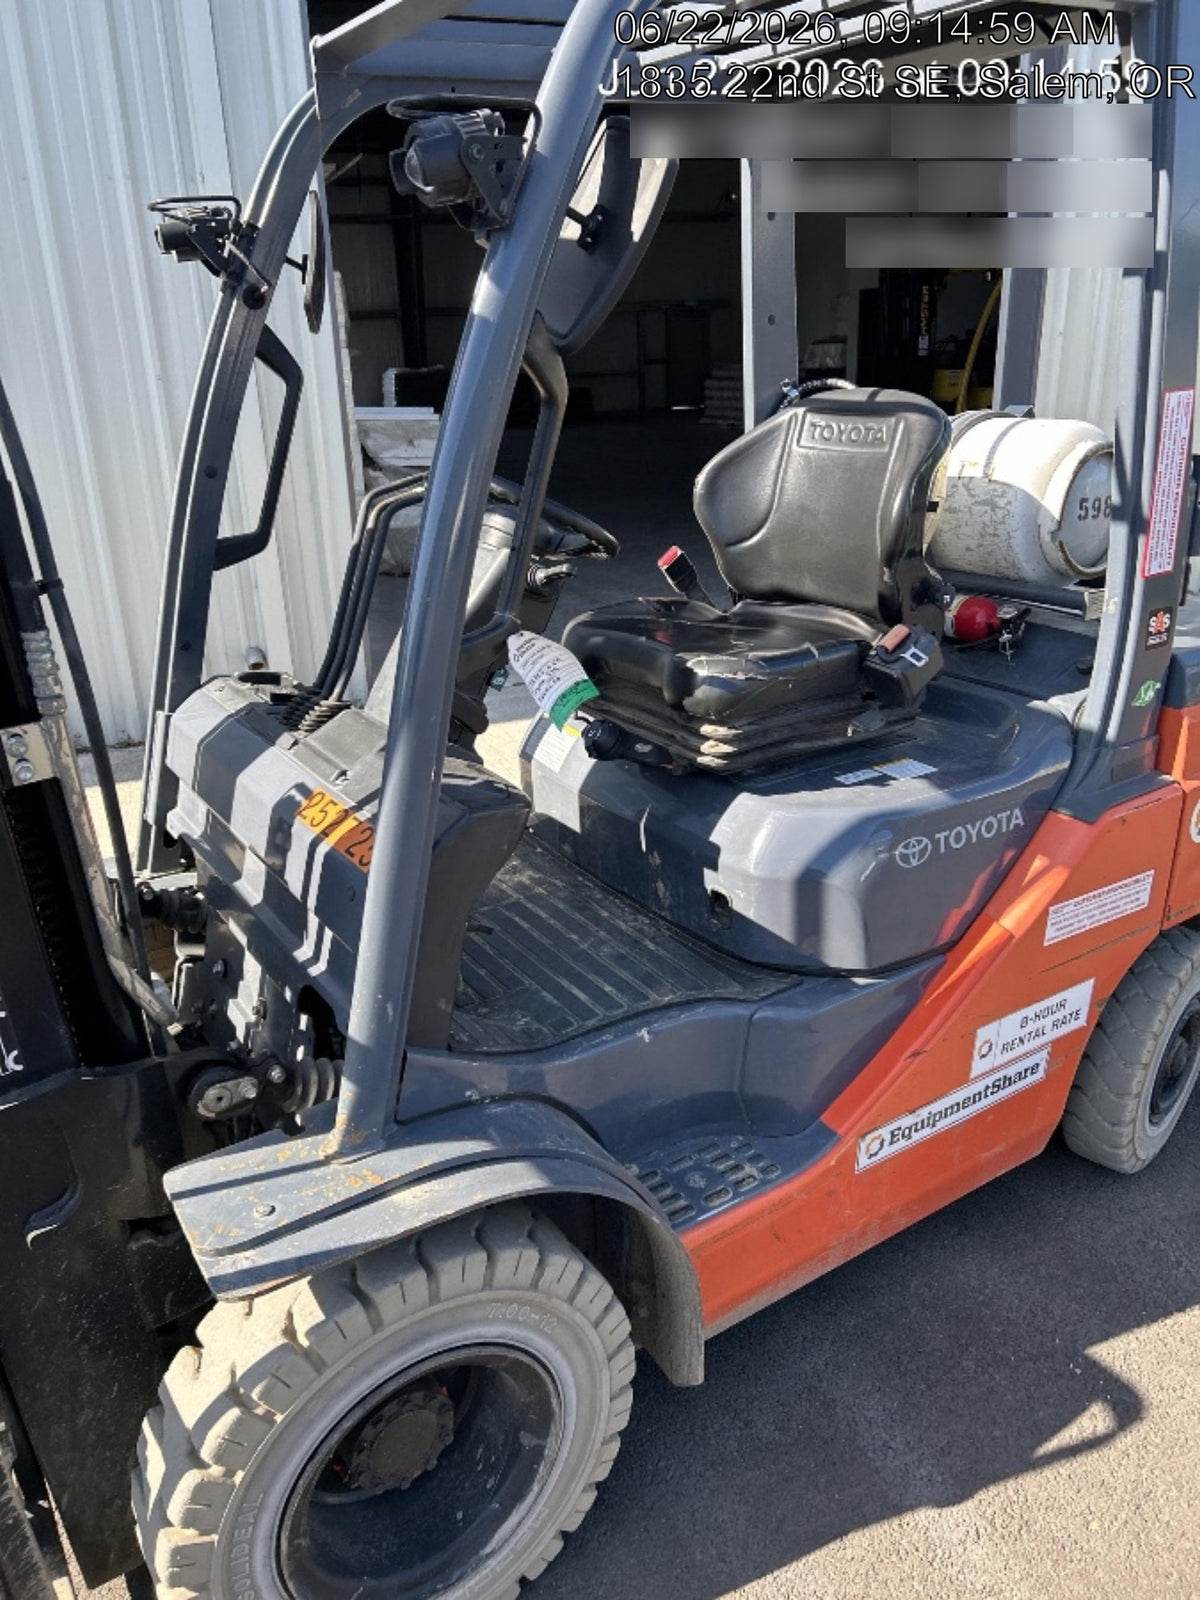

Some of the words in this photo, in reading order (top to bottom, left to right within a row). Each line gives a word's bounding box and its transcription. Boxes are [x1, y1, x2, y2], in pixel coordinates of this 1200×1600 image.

[810, 419, 888, 444] TOYOTA
[934, 807, 1025, 854] TOYOTA
[1000, 1025, 1047, 1055] RENTAL
[1050, 1007, 1082, 1032] RATE
[888, 1061, 1041, 1147] EquipmentShare
